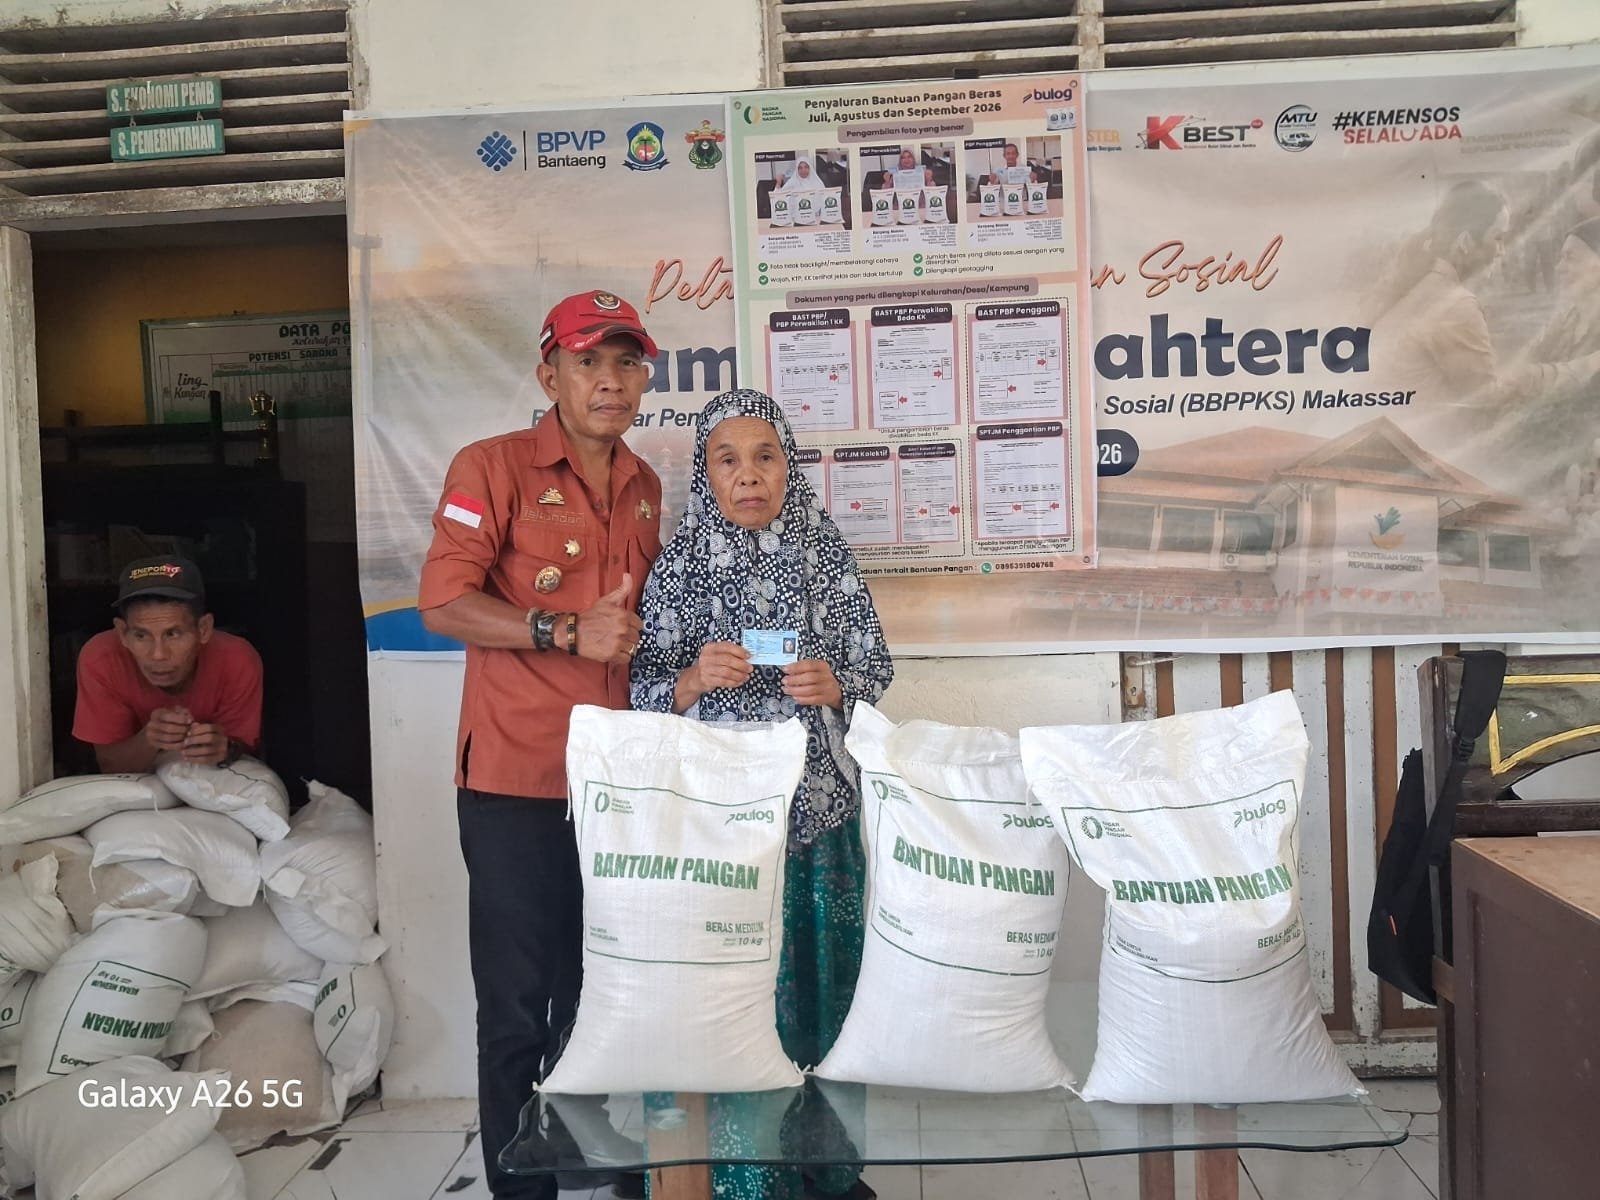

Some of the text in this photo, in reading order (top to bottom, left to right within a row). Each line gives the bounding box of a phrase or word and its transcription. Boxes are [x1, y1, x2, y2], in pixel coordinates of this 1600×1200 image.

[111, 80, 214, 112] S. EKONOMI PEMB
[805, 90, 1002, 111] Penyaluran Bantuan Pangan Beras
[1034, 88, 1072, 101] bulog
[808, 103, 1002, 124] Juli, Agustus dan September 2026
[1280, 112, 1318, 123] MTU
[1332, 106, 1460, 131] #KEMENSOS
[847, 124, 964, 138] Pengambilan foto yang benar
[1420, 124, 1462, 141] ADA
[118, 124, 216, 156] S. PEMERINTAHAN
[537, 130, 606, 152] BPVP
[538, 154, 606, 168] Bantaeng
[1139, 234, 1284, 298] Sosial
[834, 294, 854, 303] yang
[978, 308, 998, 316] BAST
[1016, 306, 1058, 315] Pengganti
[279, 324, 320, 338] DATA
[1094, 313, 1372, 380] ahtera
[248, 351, 291, 362] POTENSI
[1104, 393, 1174, 415] Sosial
[1180, 390, 1295, 417] (BBPPKS)
[1302, 388, 1416, 410] Makassar
[1100, 444, 1122, 464] 26
[944, 564, 974, 573] Pangan
[1243, 799, 1286, 822] bulog
[593, 852, 760, 890] BANTUAN PANGAN
[892, 836, 1054, 896] BANTUAN PANGAN
[1112, 863, 1293, 905] BANTUAN PANGAN
[706, 921, 734, 934] BERAS
[739, 937, 750, 946] 10
[751, 937, 764, 946] kg
[1006, 930, 1032, 944] BERAS
[1258, 931, 1282, 948] BERAS
[110, 974, 120, 982] 10
[90, 980, 140, 996] BERAS MEDIUM
[82, 1012, 174, 1040] NTUAN PANGAN
[60, 1054, 85, 1067] ulog
